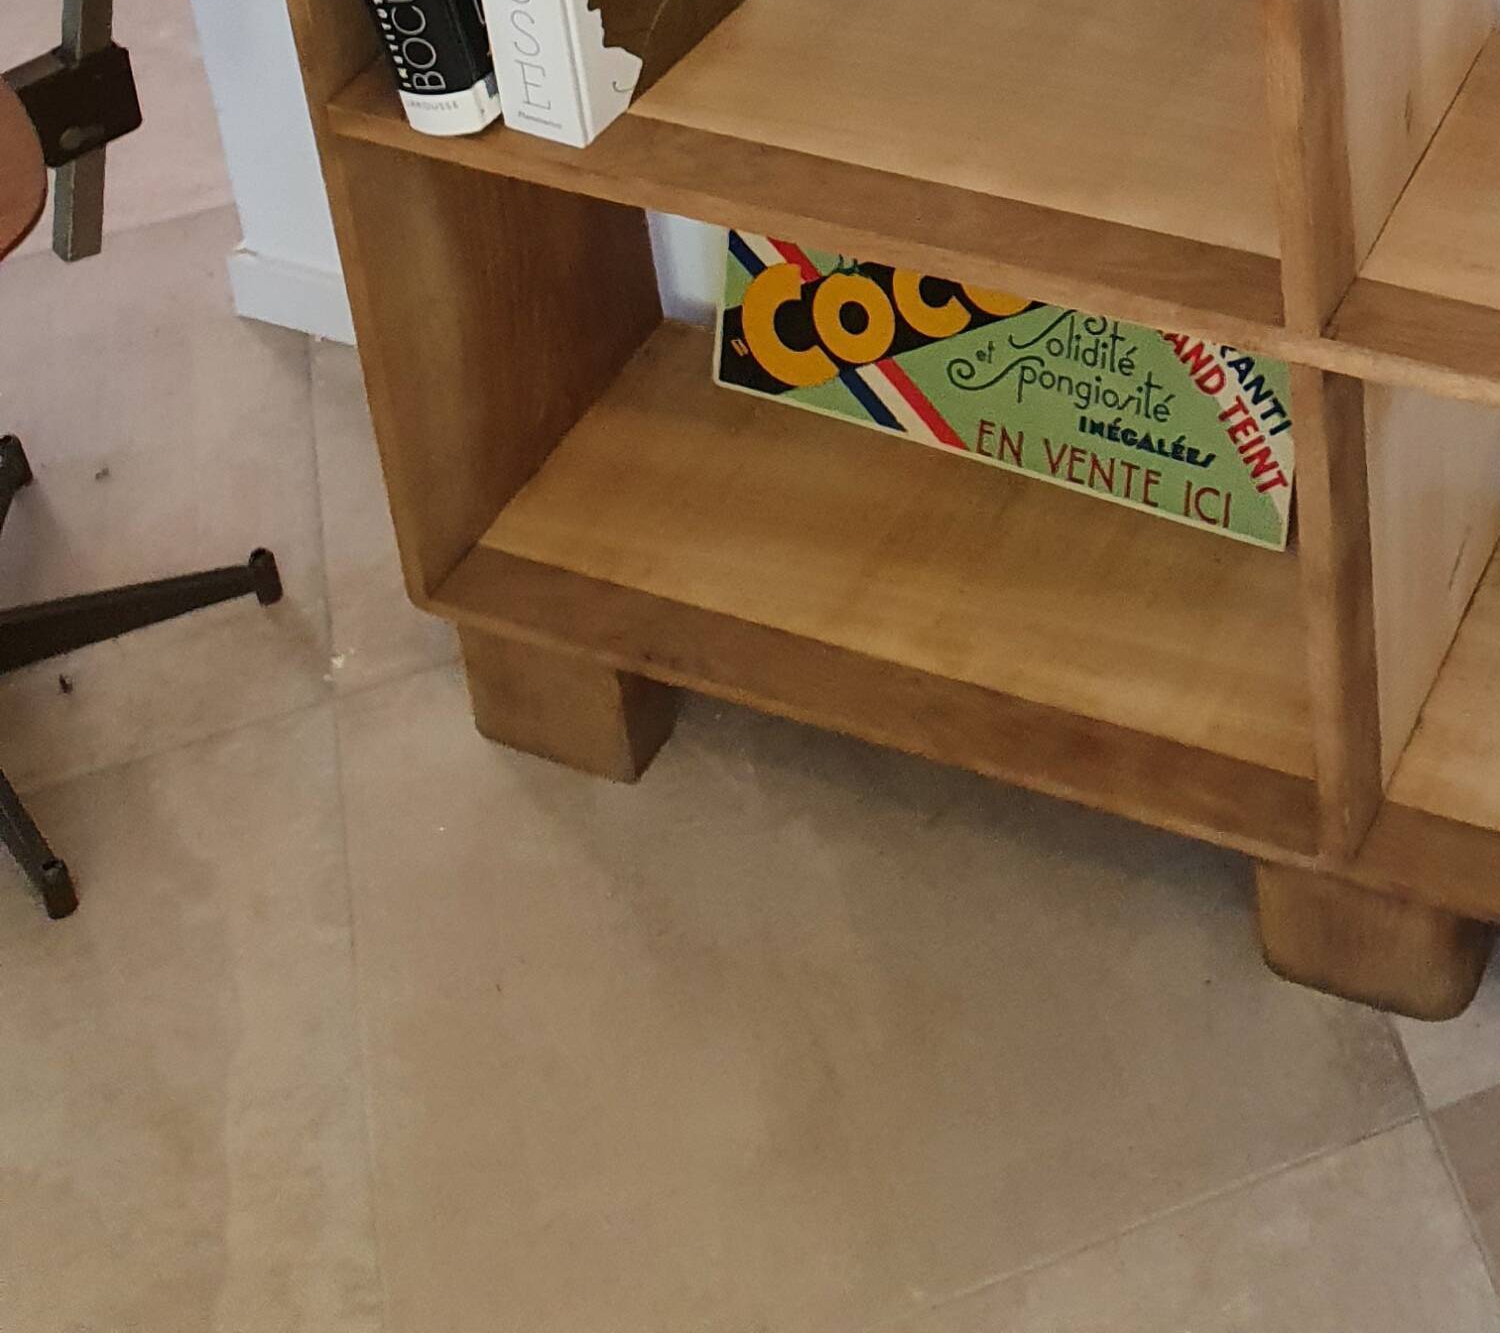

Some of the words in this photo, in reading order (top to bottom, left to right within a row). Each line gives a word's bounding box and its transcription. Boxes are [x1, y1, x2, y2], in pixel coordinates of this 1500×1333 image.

[976, 340, 995, 364] et
[1009, 309, 1138, 376] Solidité
[947, 355, 1176, 423] Spongiosité
[1157, 330, 1226, 395] AND
[1218, 395, 1288, 493] TEINT
[975, 419, 1024, 468] EN
[1043, 437, 1162, 508] VENTE
[1184, 481, 1232, 528] ICI
